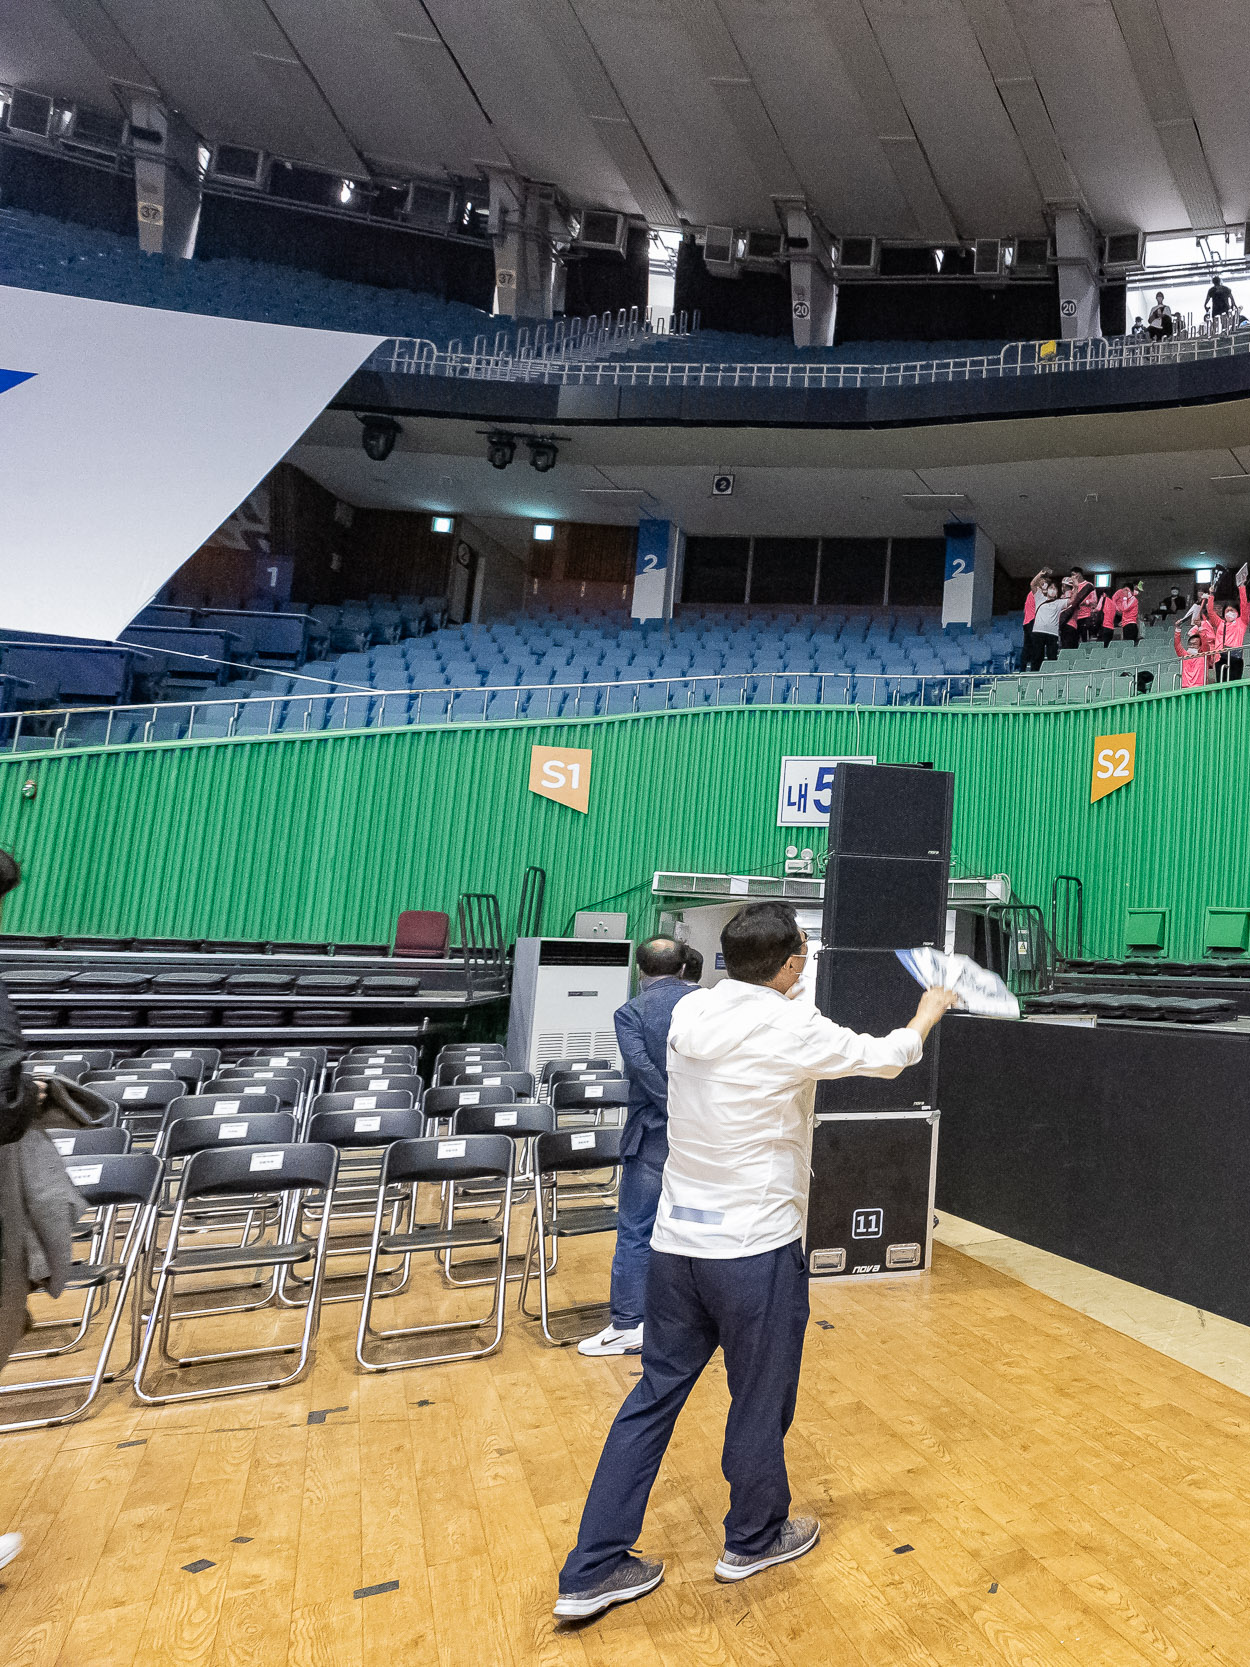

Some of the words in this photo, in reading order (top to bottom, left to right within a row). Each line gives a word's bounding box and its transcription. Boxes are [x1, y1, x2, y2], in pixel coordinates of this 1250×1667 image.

[141, 206, 160, 219] 37
[499, 273, 513, 284] 37
[796, 304, 808, 316] 20
[1063, 303, 1075, 314] 20
[643, 554, 658, 573] 2
[952, 559, 966, 577] 2
[267, 566, 278, 587] 1
[1097, 749, 1130, 779] S2
[541, 760, 580, 789] S1
[856, 1214, 878, 1233] 11
[852, 1264, 881, 1273] nova
